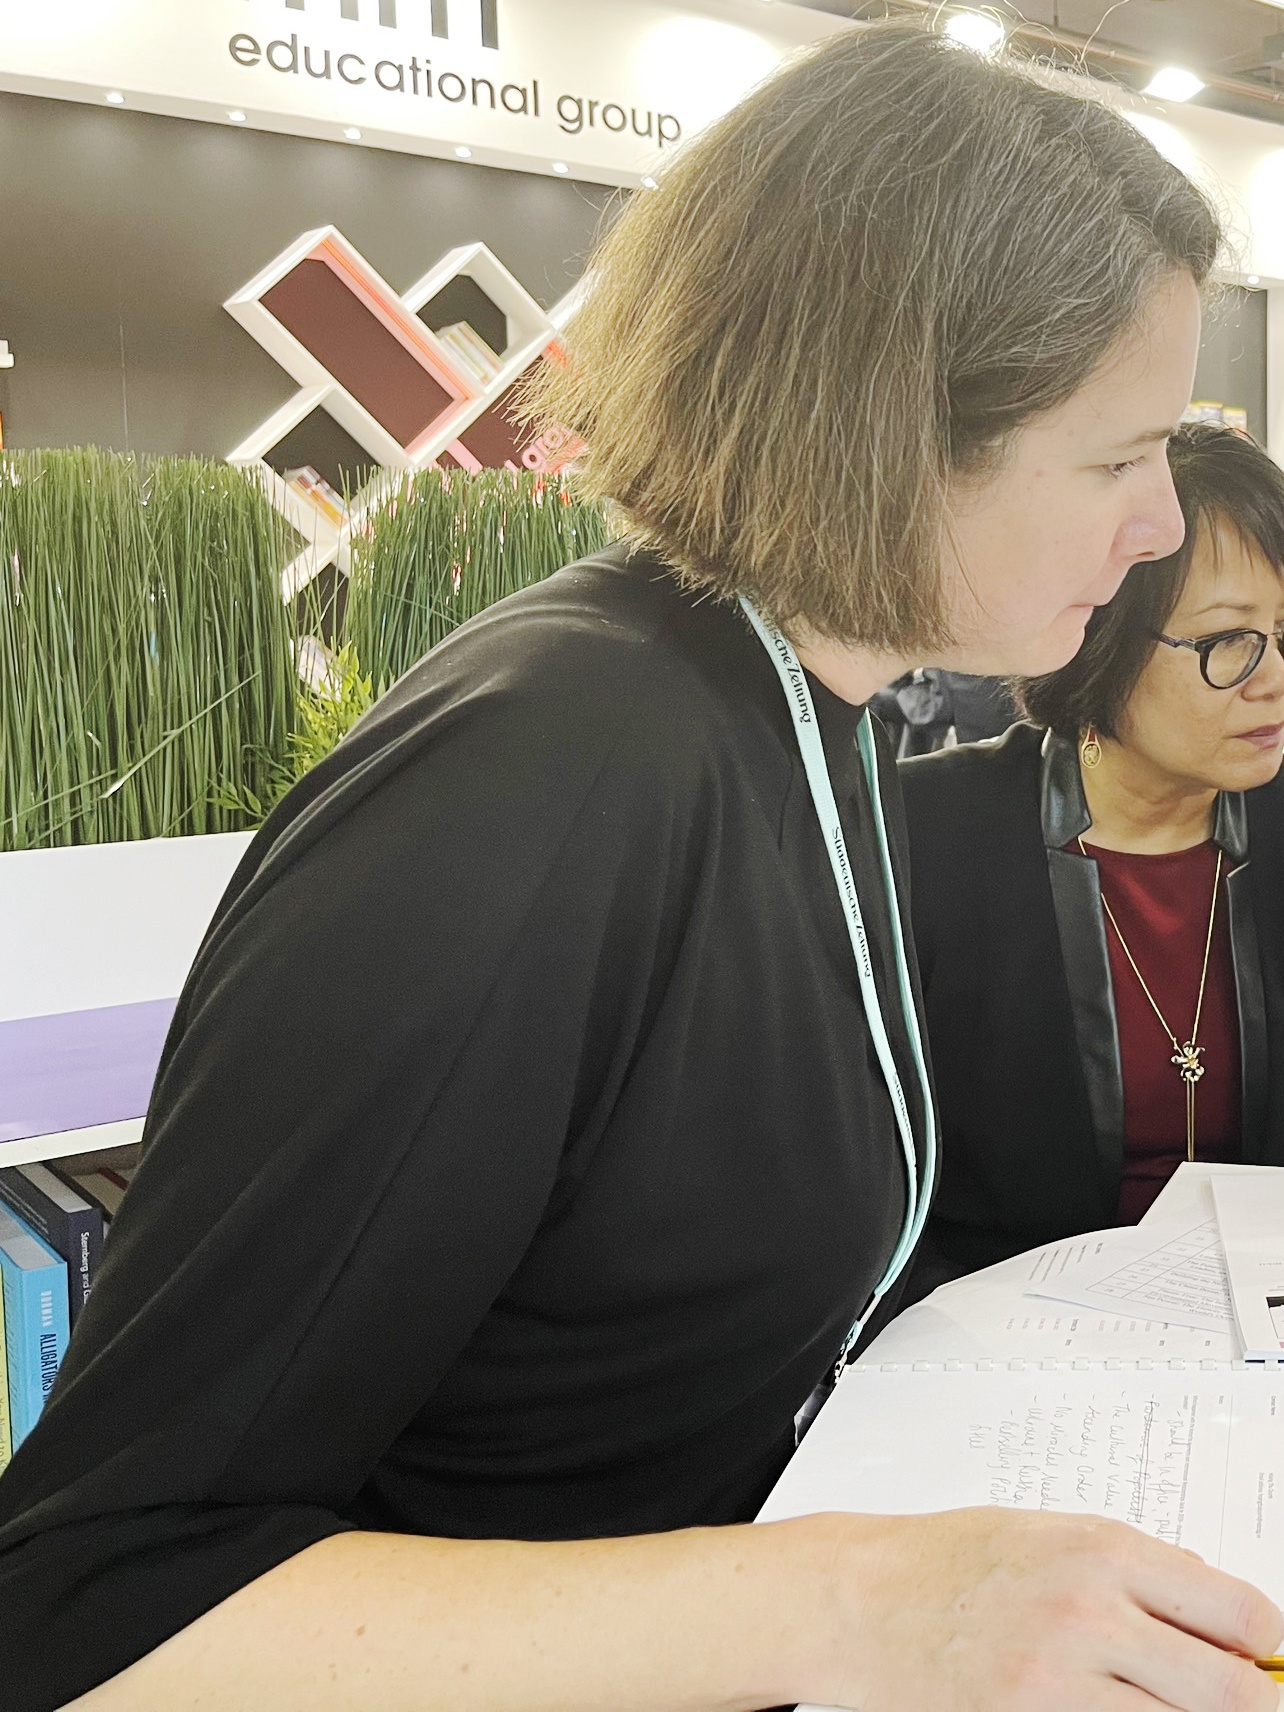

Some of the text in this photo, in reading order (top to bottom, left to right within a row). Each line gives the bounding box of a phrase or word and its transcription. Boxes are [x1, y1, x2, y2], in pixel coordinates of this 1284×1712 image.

[228, 33, 682, 148] educational group
[787, 662, 812, 725] Zeitung
[80, 1231, 91, 1273] Sternberg
[83, 1273, 91, 1289] and
[40, 1333, 58, 1392] ALLIGATORS
[1053, 1406, 1072, 1418] No
[1112, 1403, 1131, 1419] The
[1040, 1472, 1060, 1511] Neede
[1075, 1465, 1095, 1503] Order
